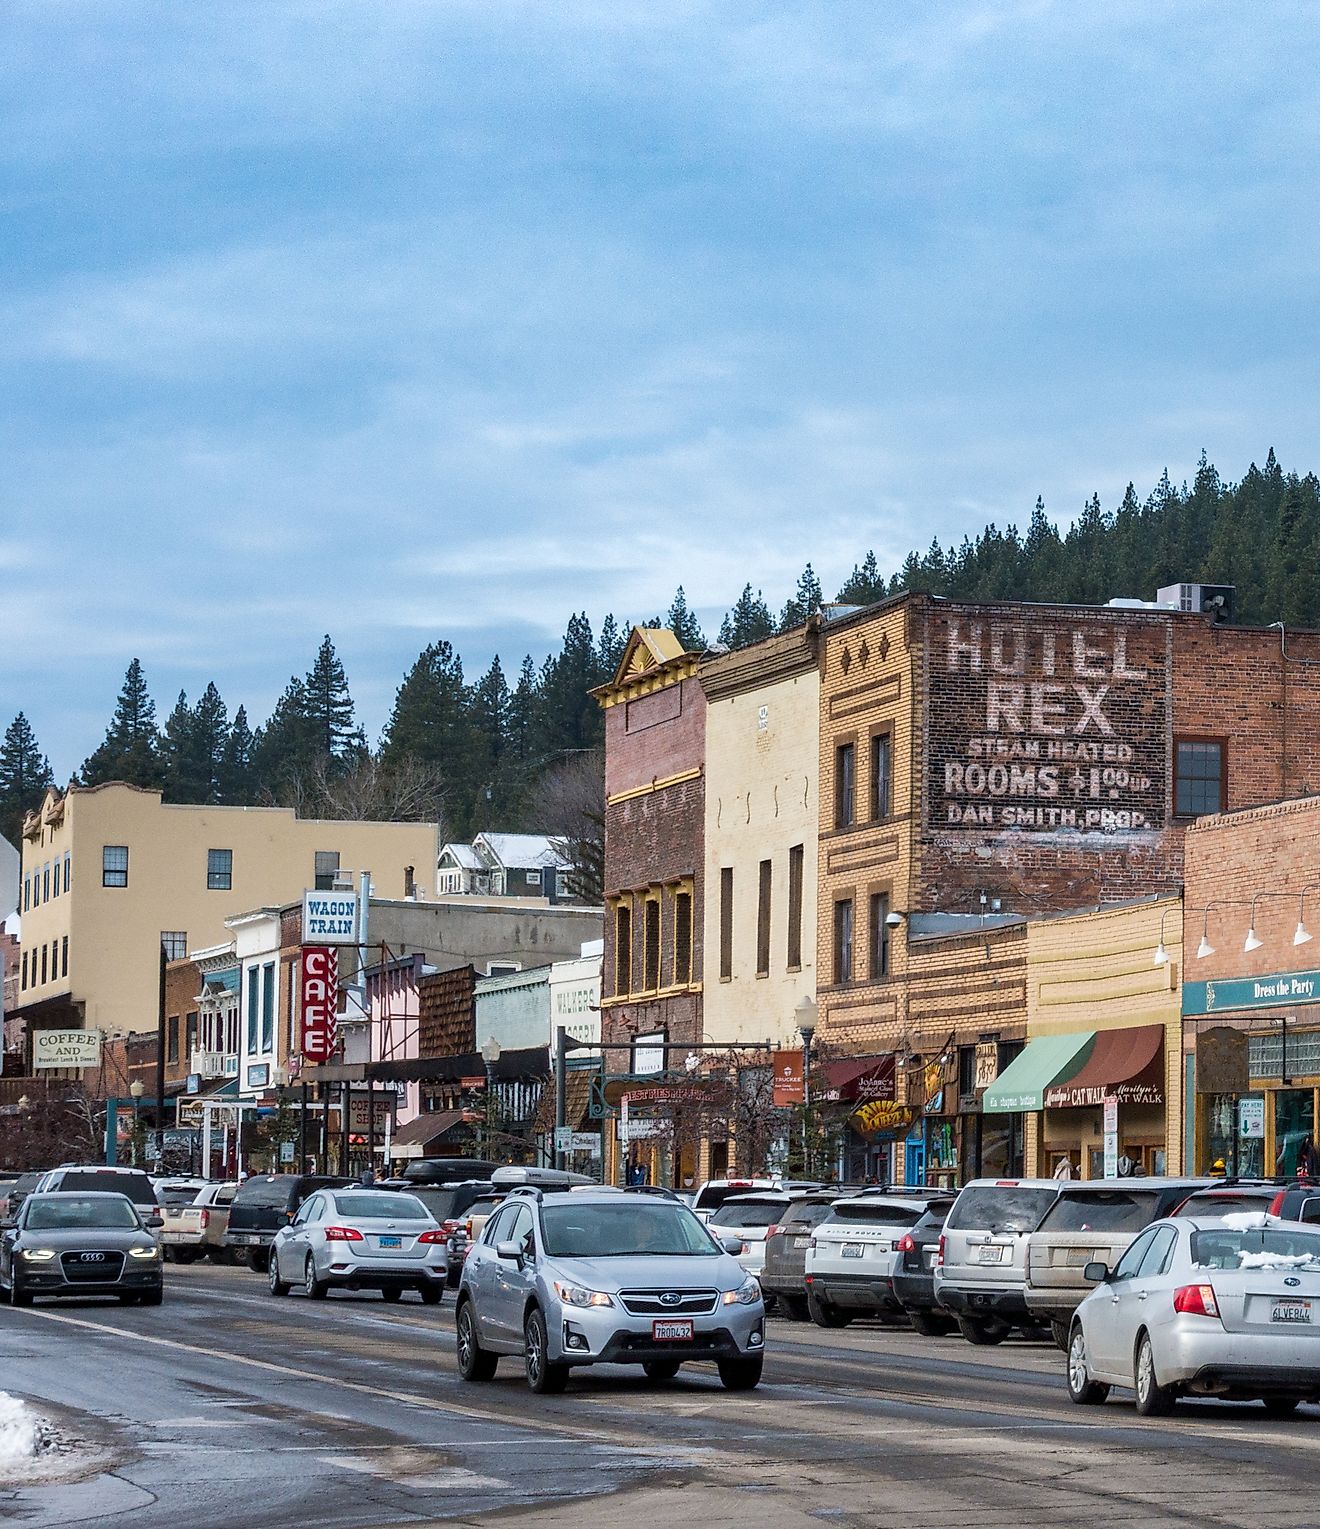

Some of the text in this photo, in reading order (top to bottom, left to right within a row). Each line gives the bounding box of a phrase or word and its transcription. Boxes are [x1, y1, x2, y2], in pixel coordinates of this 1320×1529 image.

[948, 619, 1147, 679] HOTEL
[986, 680, 1117, 736] REX
[968, 738, 1132, 763] STEAM HEATED
[944, 763, 1059, 798] ROOMS
[948, 804, 993, 824] DAN
[308, 901, 355, 916] WAGON
[309, 919, 352, 934] TRAIN
[1254, 978, 1315, 998] Dress the Party
[305, 953, 326, 1053] CAFE
[39, 1033, 97, 1047] COFFEE
[55, 1047, 81, 1055] AND
[1044, 1086, 1107, 1108] Marilyn's CAT WALK
[1117, 1084, 1159, 1097] Marilyn's
[1132, 1094, 1163, 1104] WALK
[351, 1100, 390, 1112] COFEE
